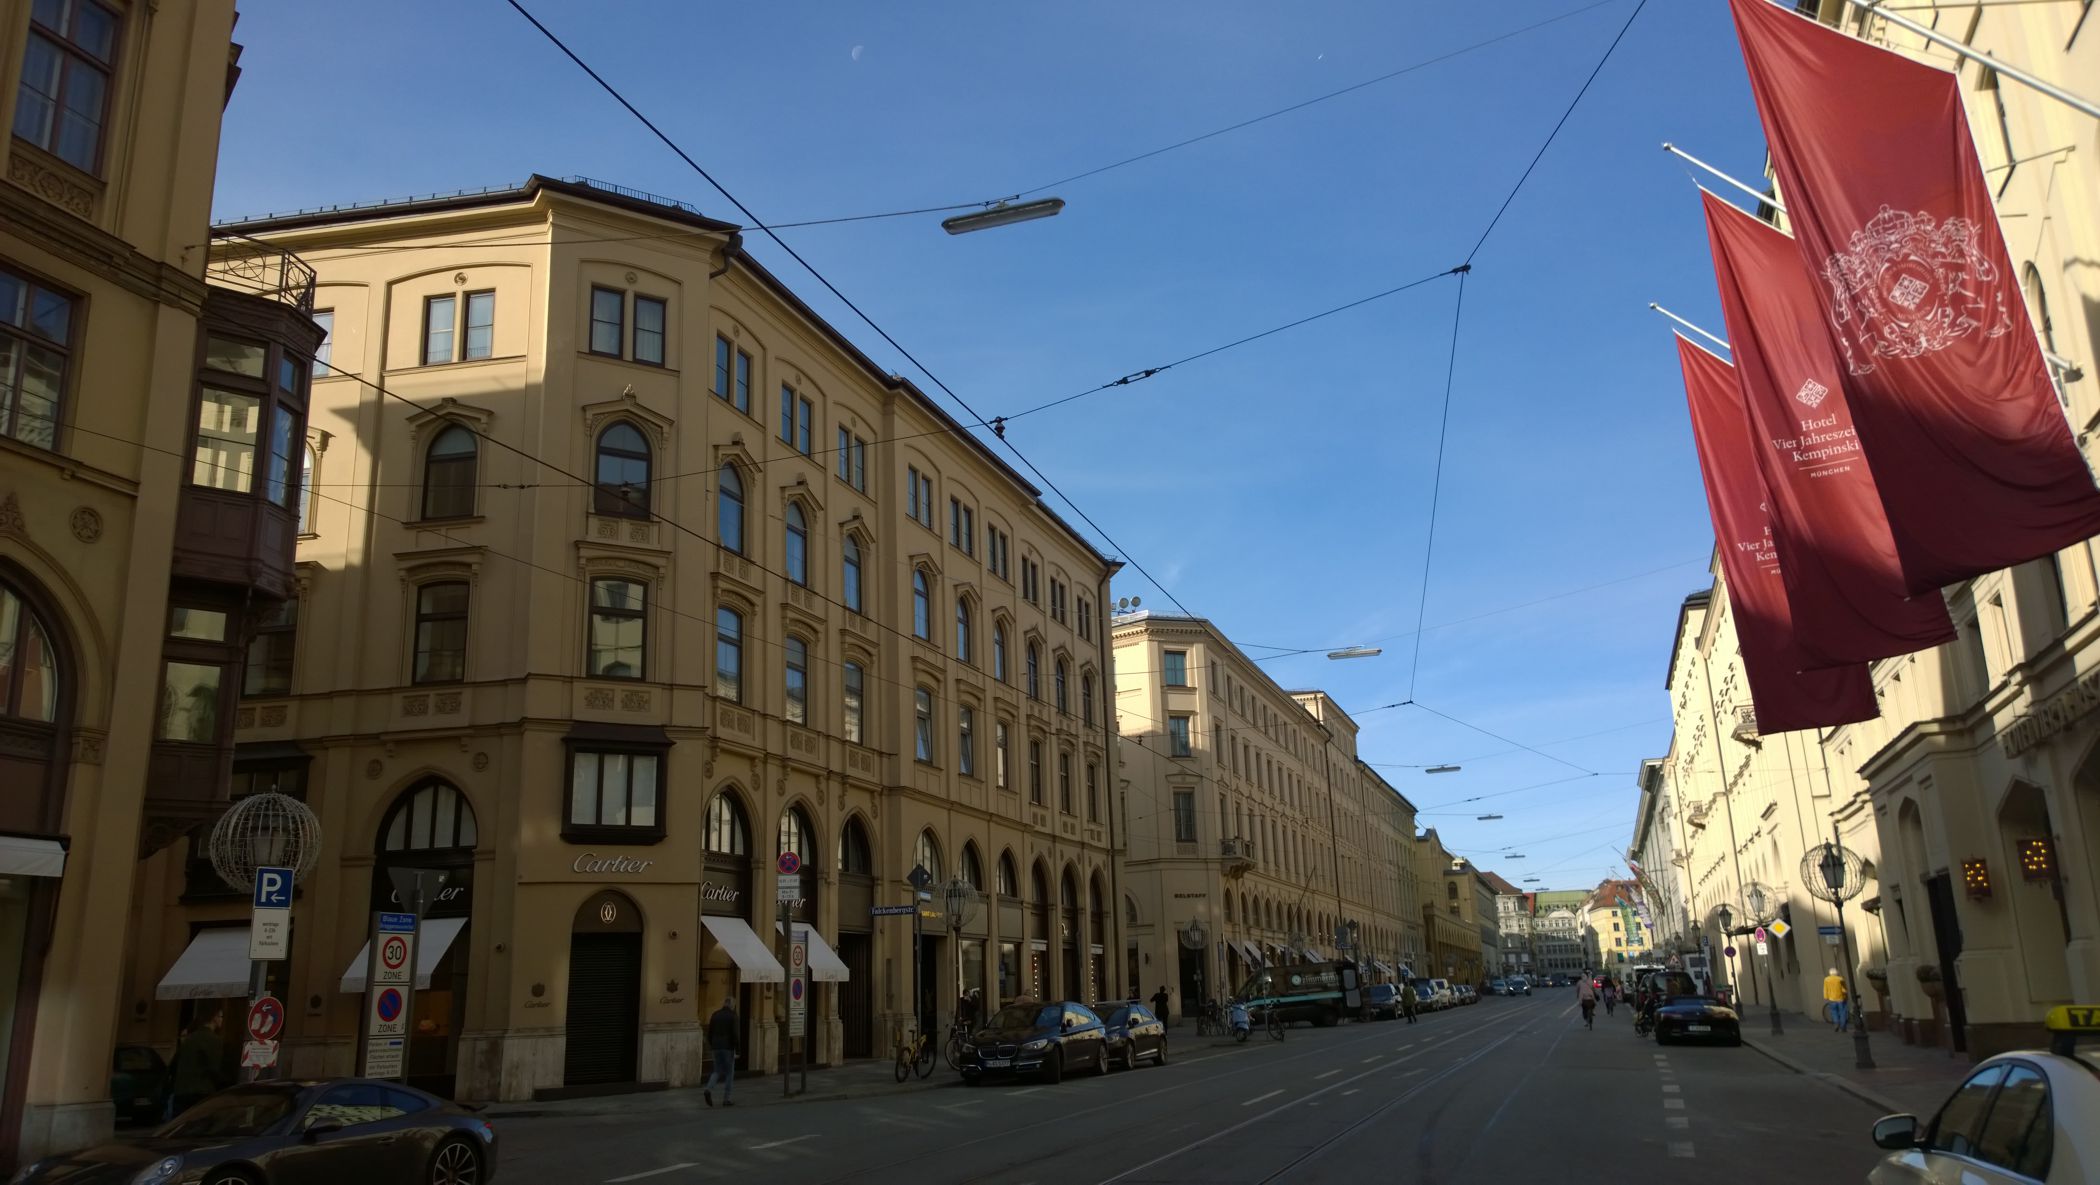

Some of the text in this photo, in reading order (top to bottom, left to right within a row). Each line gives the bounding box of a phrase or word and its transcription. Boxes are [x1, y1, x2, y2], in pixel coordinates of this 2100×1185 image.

[1801, 413, 1837, 431] Hotel
[1772, 425, 1857, 451] Vier Jahreszei
[1792, 440, 1860, 462] Kempinski
[1810, 465, 1851, 478] MÜNCHEN
[1737, 542, 1760, 552] Vier
[573, 852, 652, 873] Cartier
[260, 872, 282, 903] P
[701, 880, 740, 902] Cartier
[387, 945, 402, 961] 30
[383, 971, 402, 980] ZONE
[378, 1024, 398, 1033] ZONE
